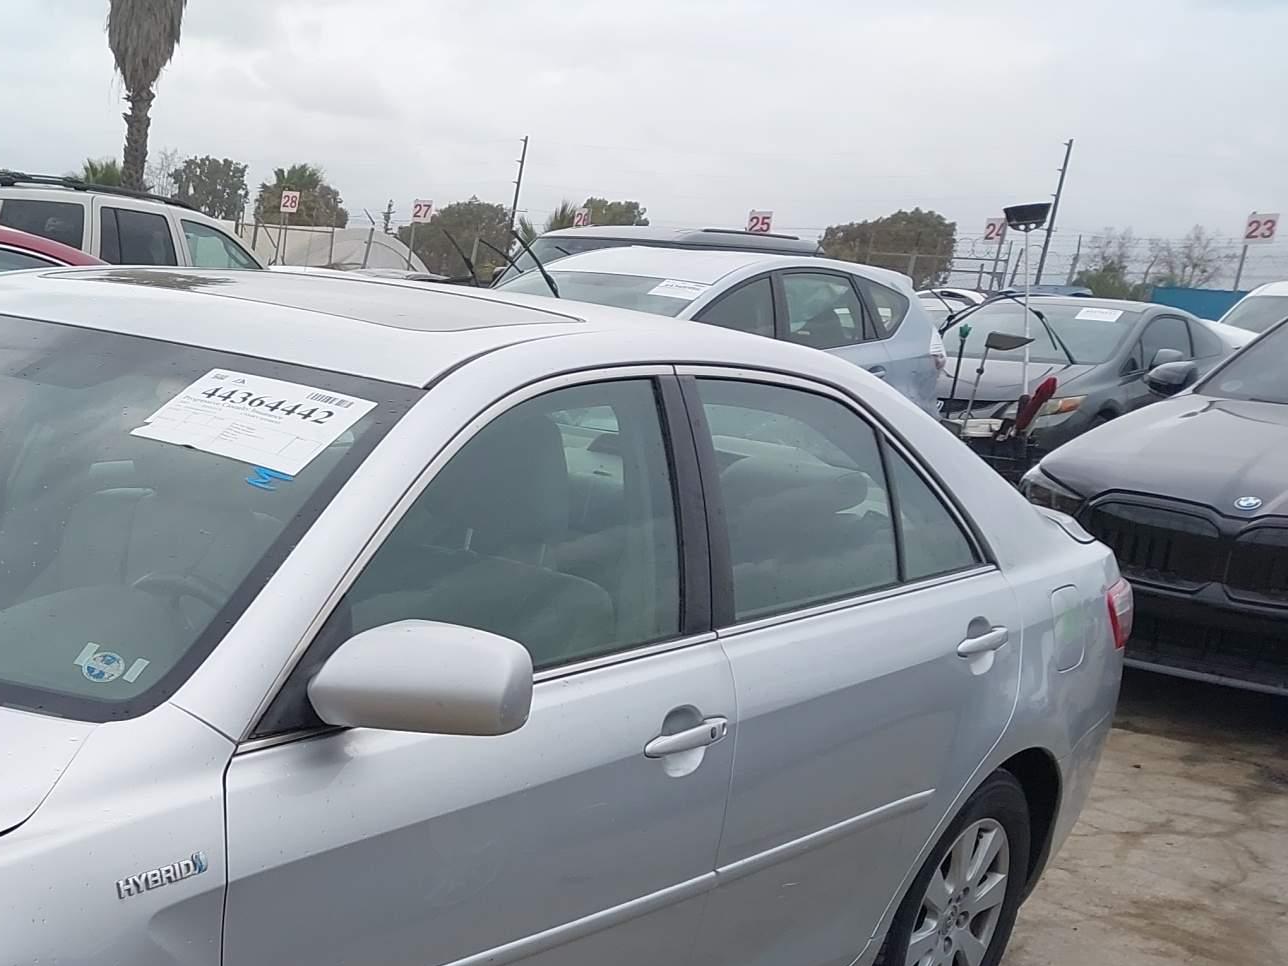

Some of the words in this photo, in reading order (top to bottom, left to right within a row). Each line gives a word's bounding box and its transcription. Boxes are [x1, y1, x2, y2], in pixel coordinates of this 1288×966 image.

[282, 194, 297, 209] 28
[413, 203, 432, 218] 27
[749, 216, 772, 232] 25
[1245, 219, 1276, 239] 23
[201, 386, 334, 424] 44364442
[116, 859, 194, 899] HYBRID
